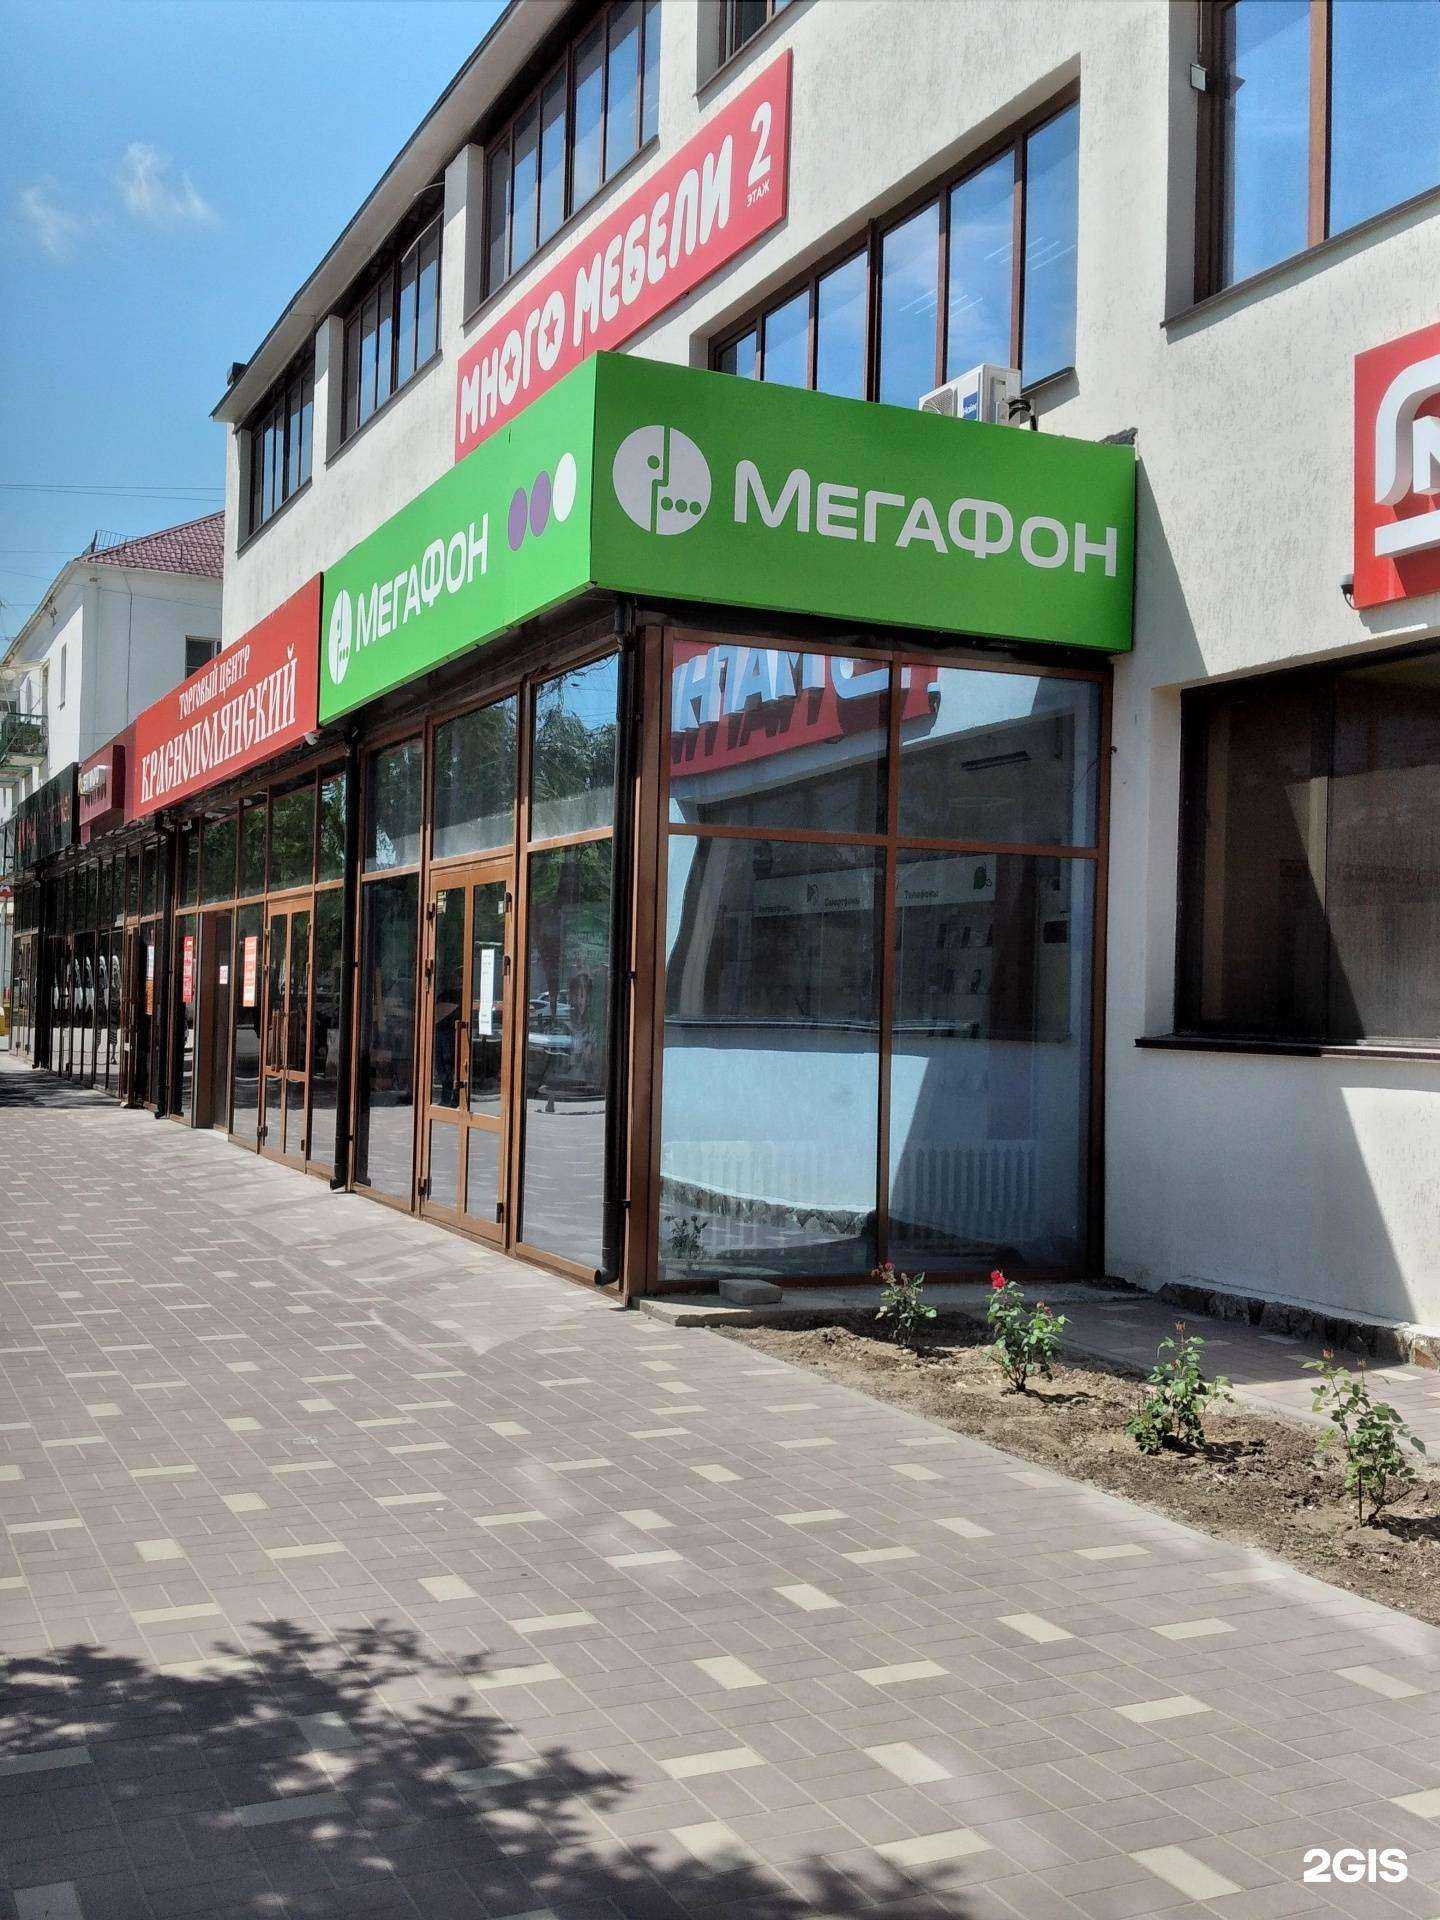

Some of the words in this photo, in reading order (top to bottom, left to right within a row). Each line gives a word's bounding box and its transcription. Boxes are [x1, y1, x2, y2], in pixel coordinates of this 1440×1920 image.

[745, 178, 770, 208] ЭТАЖ
[460, 290, 565, 443] МНОГО
[573, 134, 733, 347] МЕБЕЛИ
[747, 101, 772, 189] 2
[355, 512, 488, 653] МЕГАФОН
[733, 459, 1118, 577] МЕГАФОН
[140, 642, 297, 804] КРАСНОПОЛЯНСКИЙ
